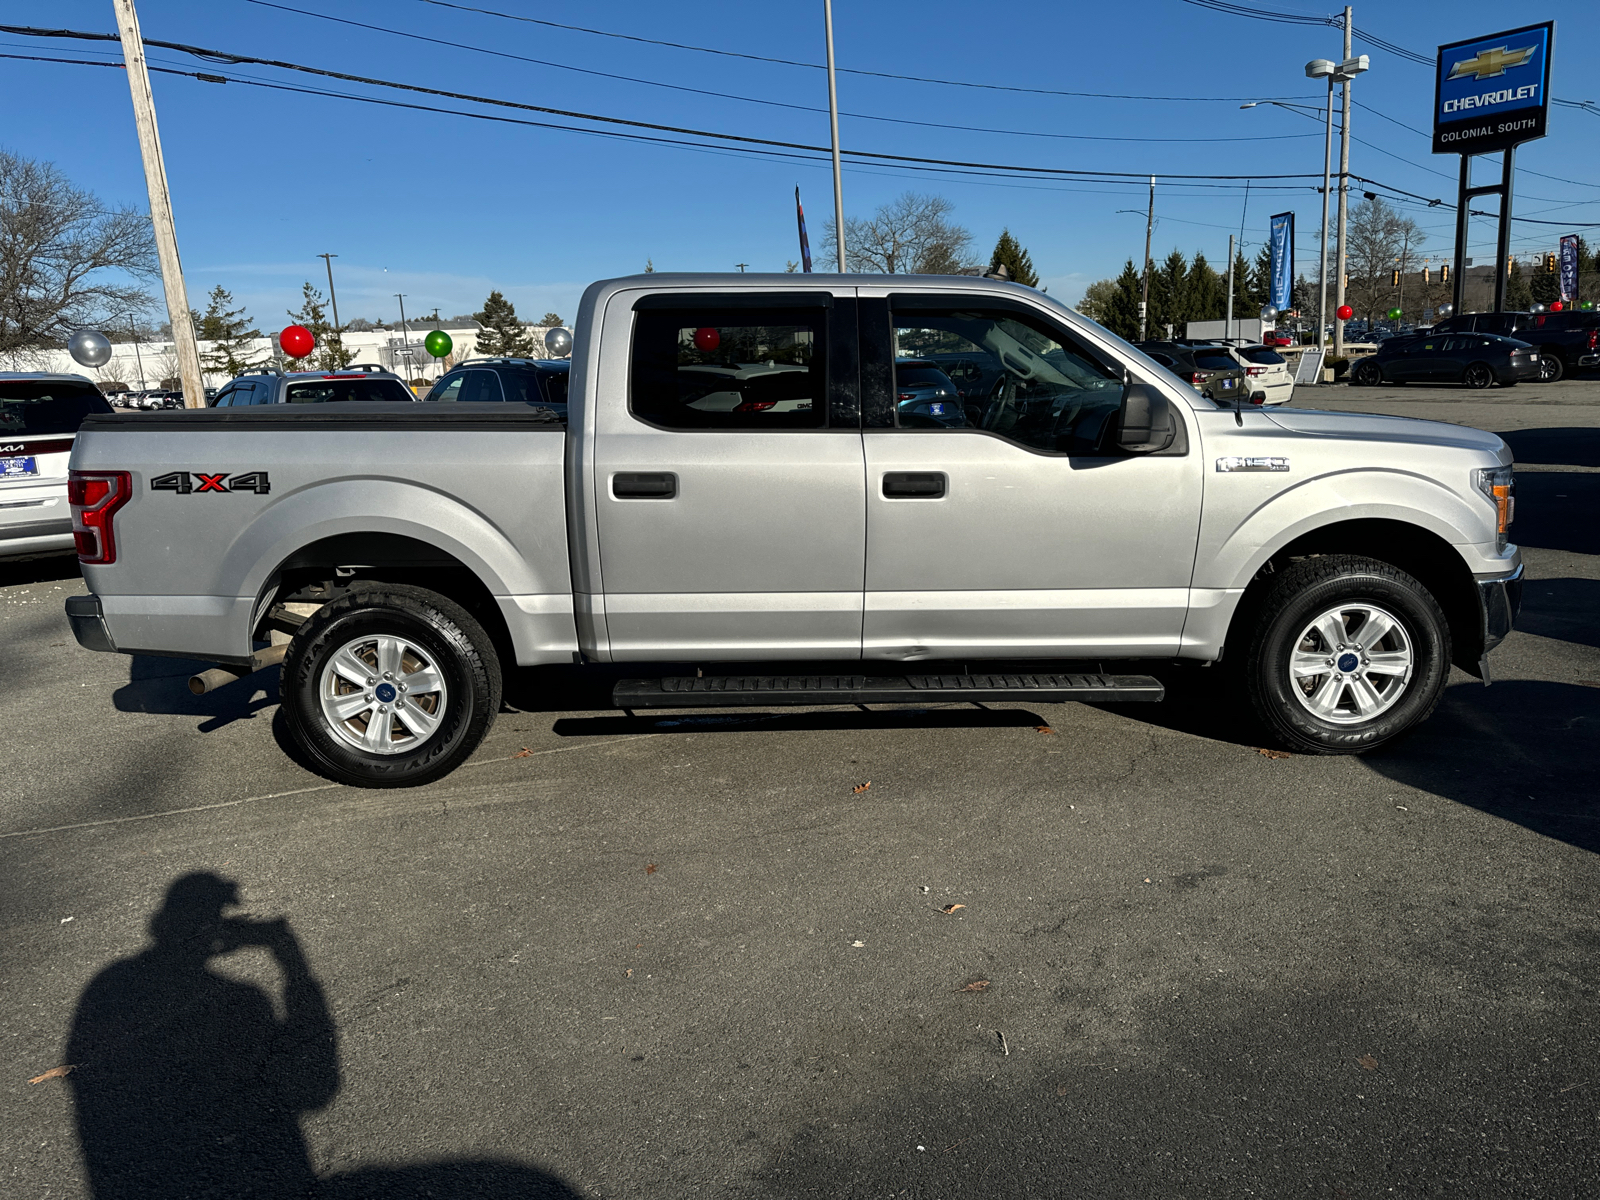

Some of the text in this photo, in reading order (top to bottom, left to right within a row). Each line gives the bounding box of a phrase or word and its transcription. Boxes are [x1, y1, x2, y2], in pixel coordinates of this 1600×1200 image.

[1443, 84, 1538, 113] CHEVROLET
[1441, 118, 1536, 143] COLONIAL SOUTH
[356, 699, 465, 773] GOODYEAR
[1282, 701, 1406, 743] GOODYEAR
